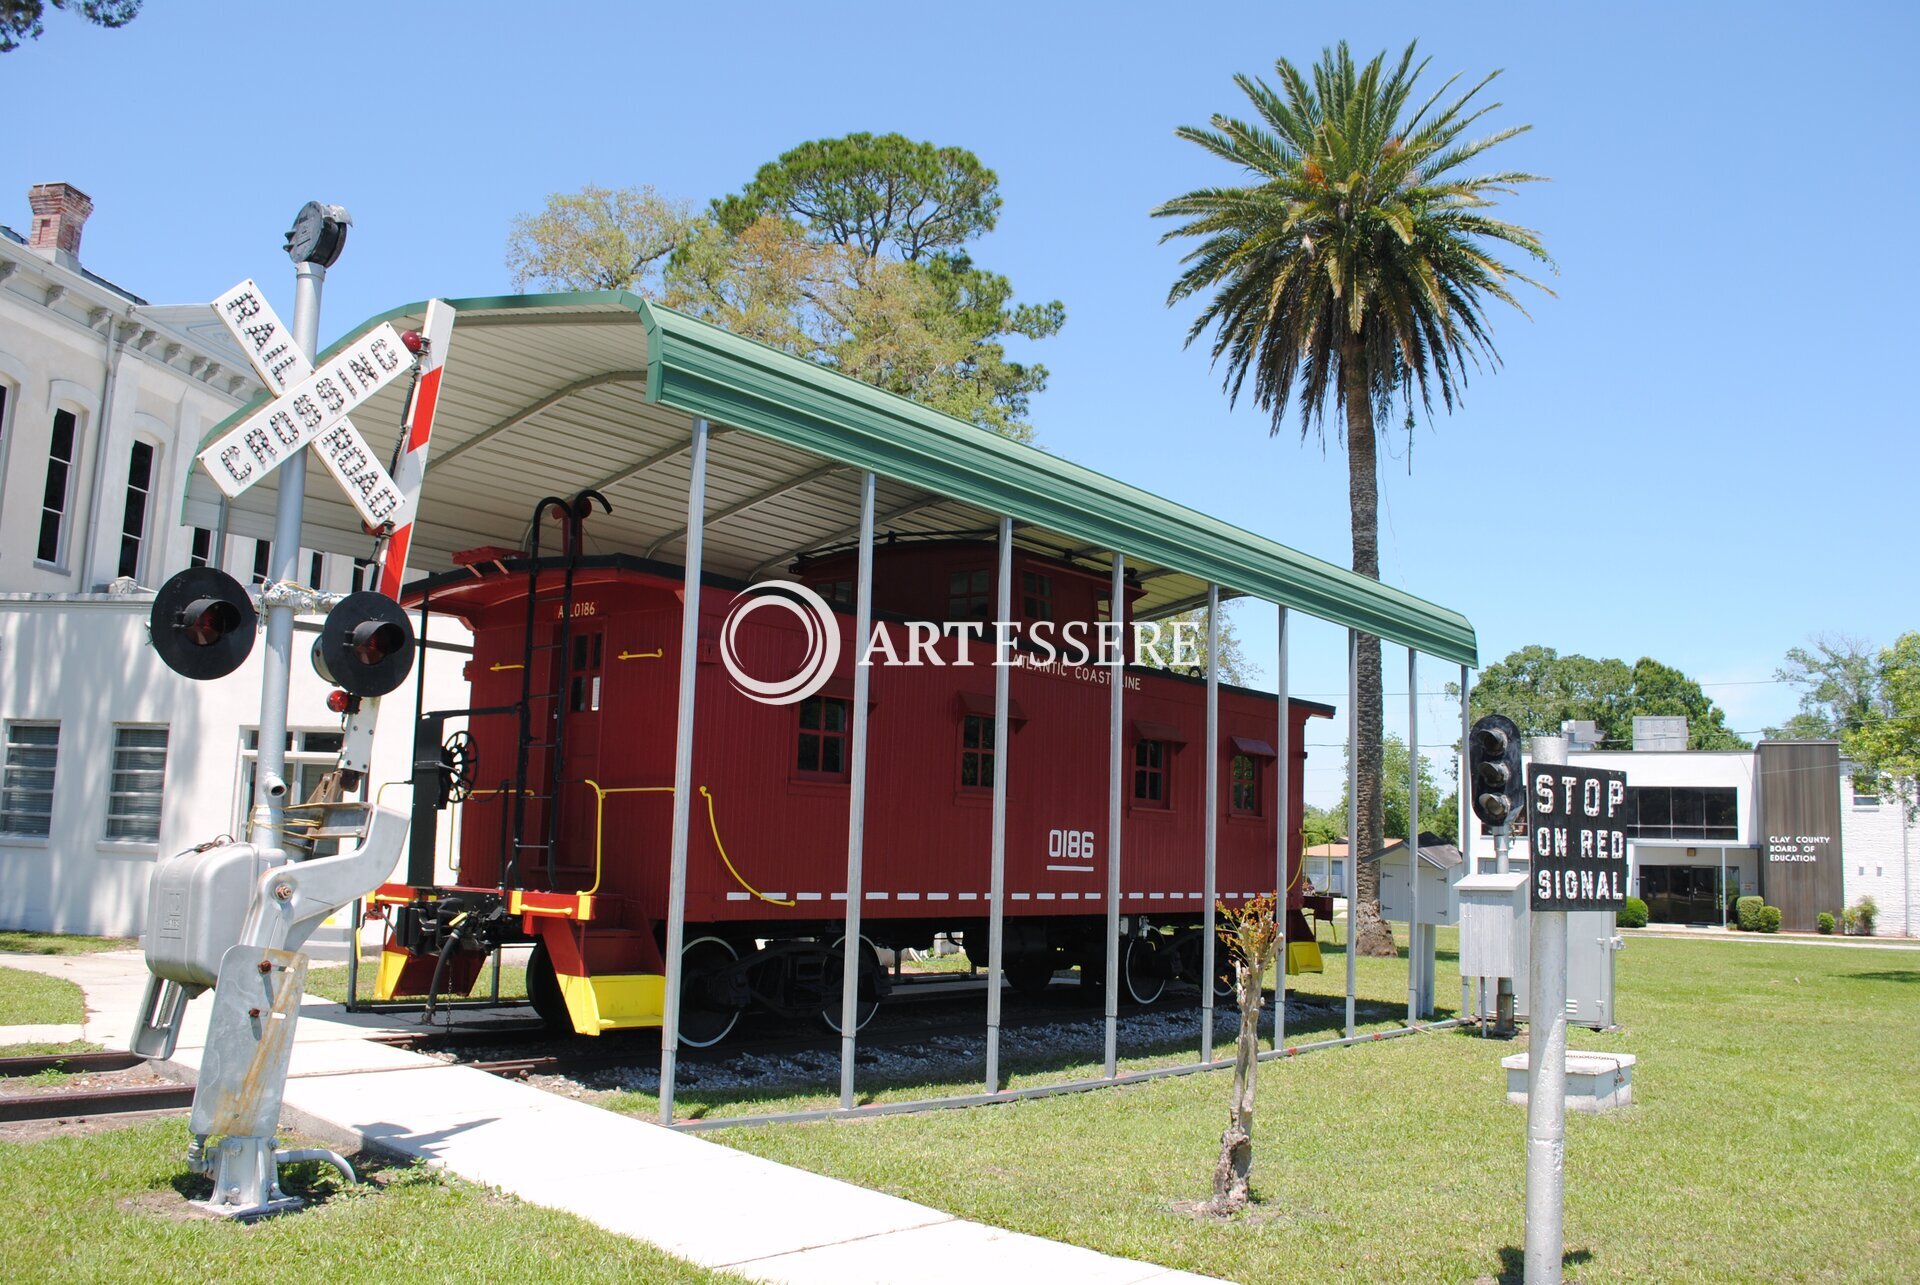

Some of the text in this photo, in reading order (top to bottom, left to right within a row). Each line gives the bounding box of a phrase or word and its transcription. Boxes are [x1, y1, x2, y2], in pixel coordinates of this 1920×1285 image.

[226, 290, 297, 387] RAIL
[220, 338, 398, 482] CROSSING
[321, 424, 397, 518] ROAD
[1074, 665, 1112, 685] COAST
[1122, 675, 1141, 691] INE
[1536, 774, 1624, 817] STOP
[1049, 829, 1094, 858] 0186
[1537, 827, 1624, 859] ON RED
[1769, 835, 1790, 843] CLAY
[1769, 854, 1816, 862] EDUCATION
[1538, 870, 1623, 899] SIGNAL
